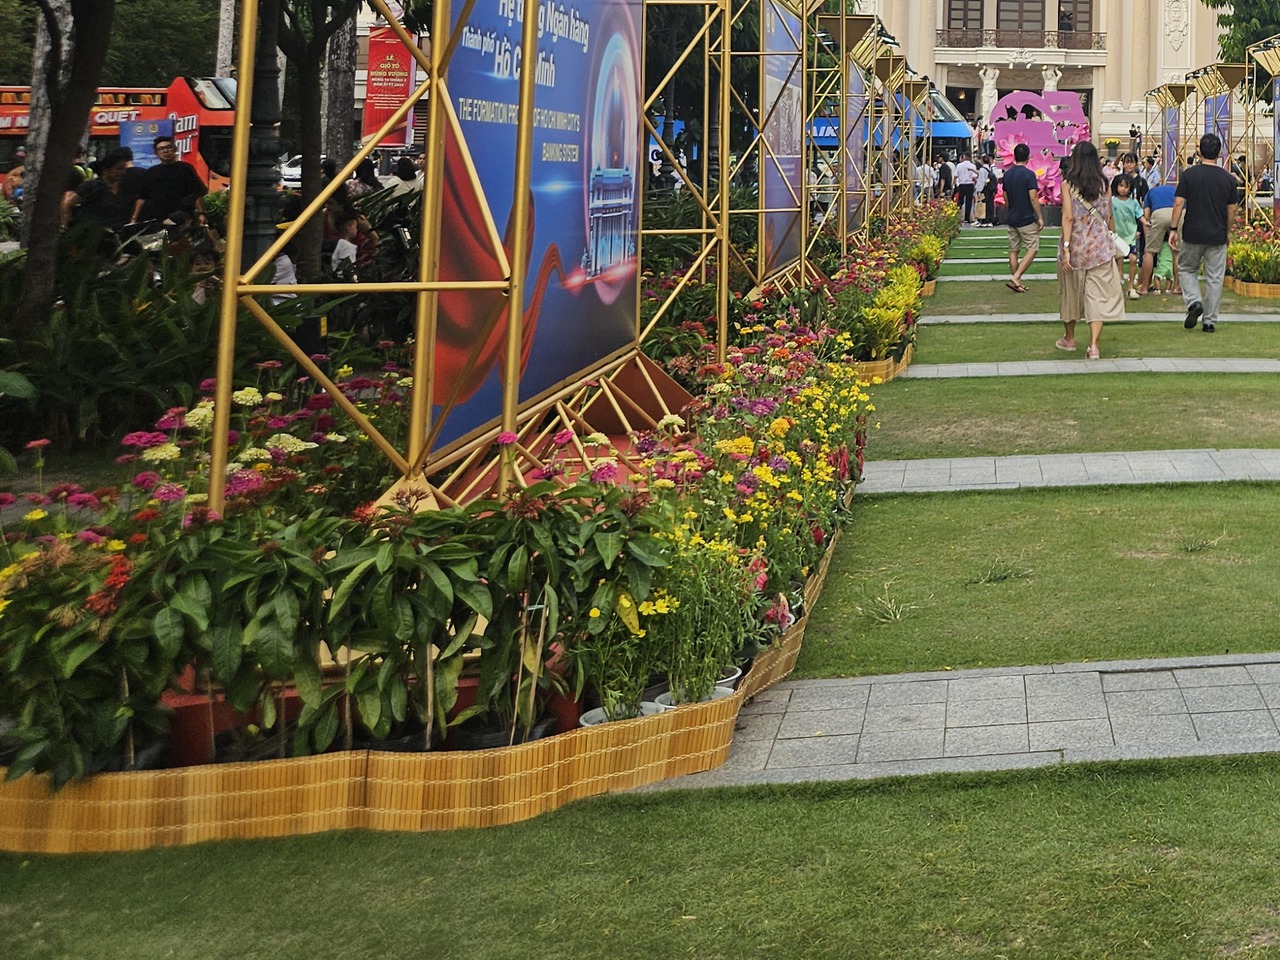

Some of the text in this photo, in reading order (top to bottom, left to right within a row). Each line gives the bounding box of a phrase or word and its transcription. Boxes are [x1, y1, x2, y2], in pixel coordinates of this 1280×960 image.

[461, 25, 496, 57] Thành phố
[546, 0, 569, 44] Ngân
[569, 8, 590, 54] hàng
[493, 36, 512, 79] Hồ
[459, 97, 473, 121] THE
[472, 99, 508, 124] FORMATION
[542, 142, 562, 161] BANKING
